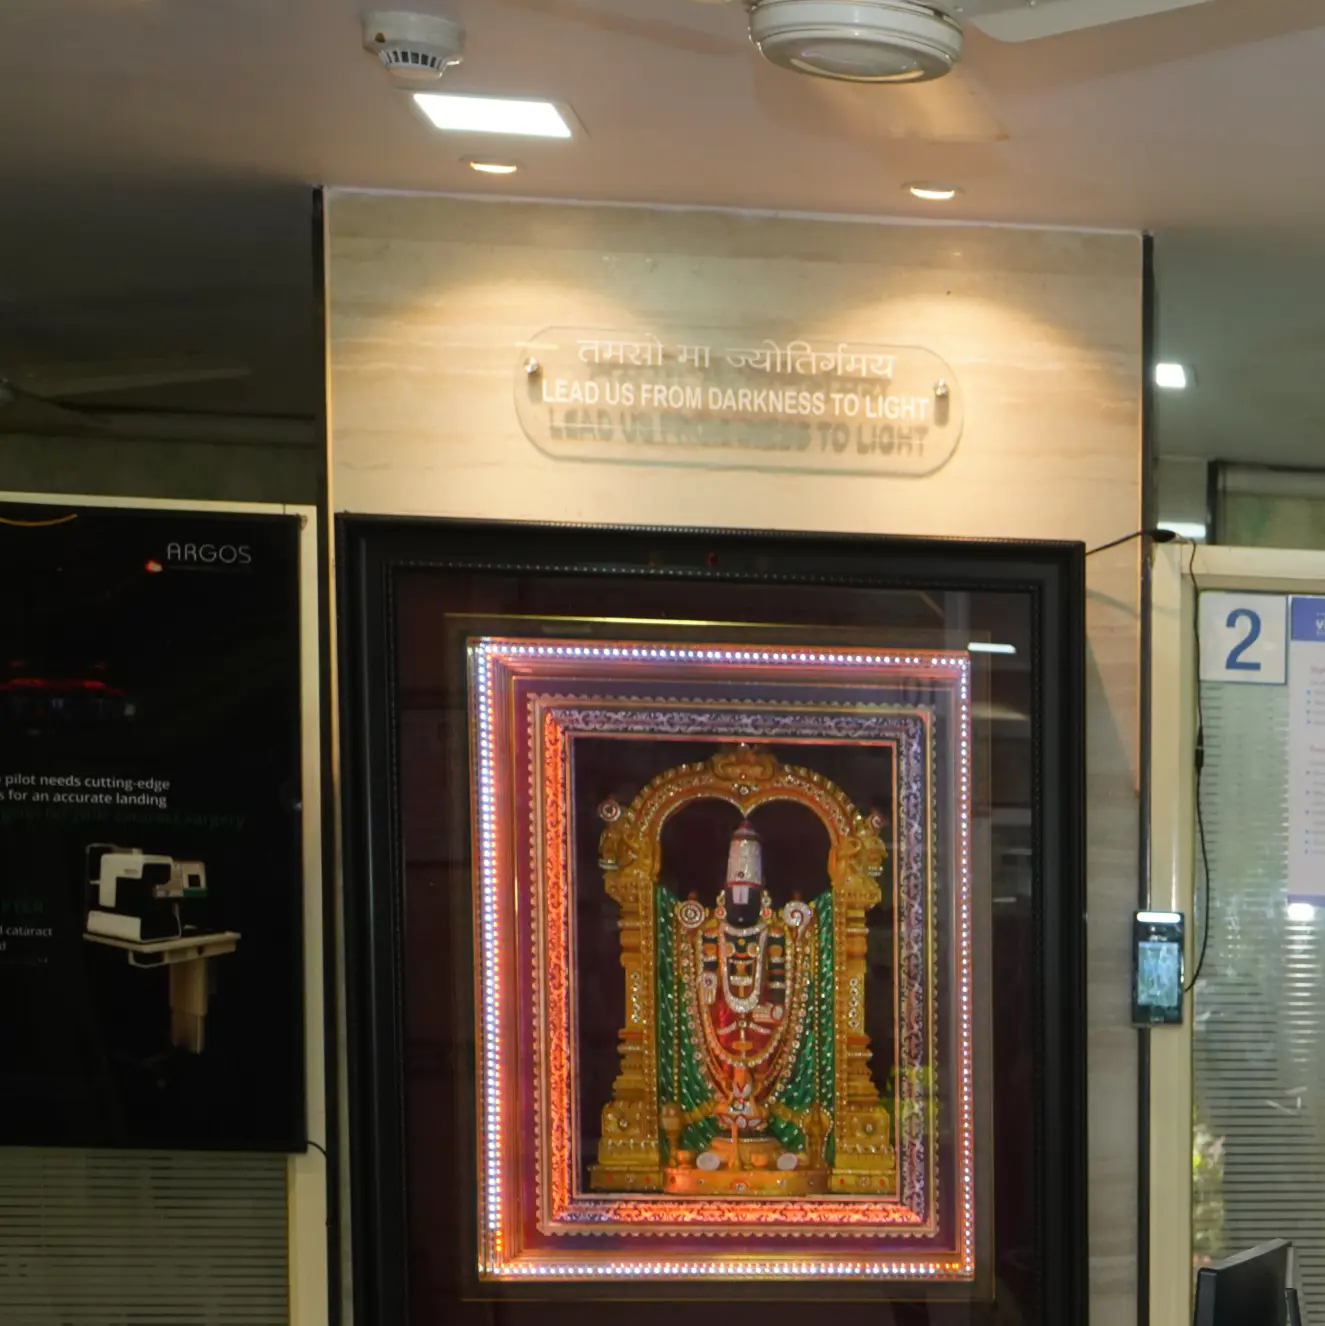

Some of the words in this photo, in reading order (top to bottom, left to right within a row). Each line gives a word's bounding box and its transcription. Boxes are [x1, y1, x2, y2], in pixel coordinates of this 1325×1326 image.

[577, 333, 664, 367] तमसो
[677, 344, 711, 369] मा
[726, 339, 898, 379] ज्योतिर्गमय
[542, 379, 599, 405] LEAD
[606, 381, 635, 407] US
[641, 383, 702, 410] FROM
[708, 386, 826, 416] DARKNESS
[830, 394, 860, 417] TO
[865, 395, 930, 420] LIGHT
[166, 541, 252, 565] ARGOS
[1225, 608, 1262, 672] 2
[5, 773, 36, 787] pilot
[40, 774, 82, 787] needs
[84, 775, 170, 793] cutting-edge
[8, 789, 28, 801] for
[32, 792, 50, 802] an
[53, 792, 113, 804] accurate
[116, 792, 168, 809] landing
[6, 926, 53, 937] cataract
